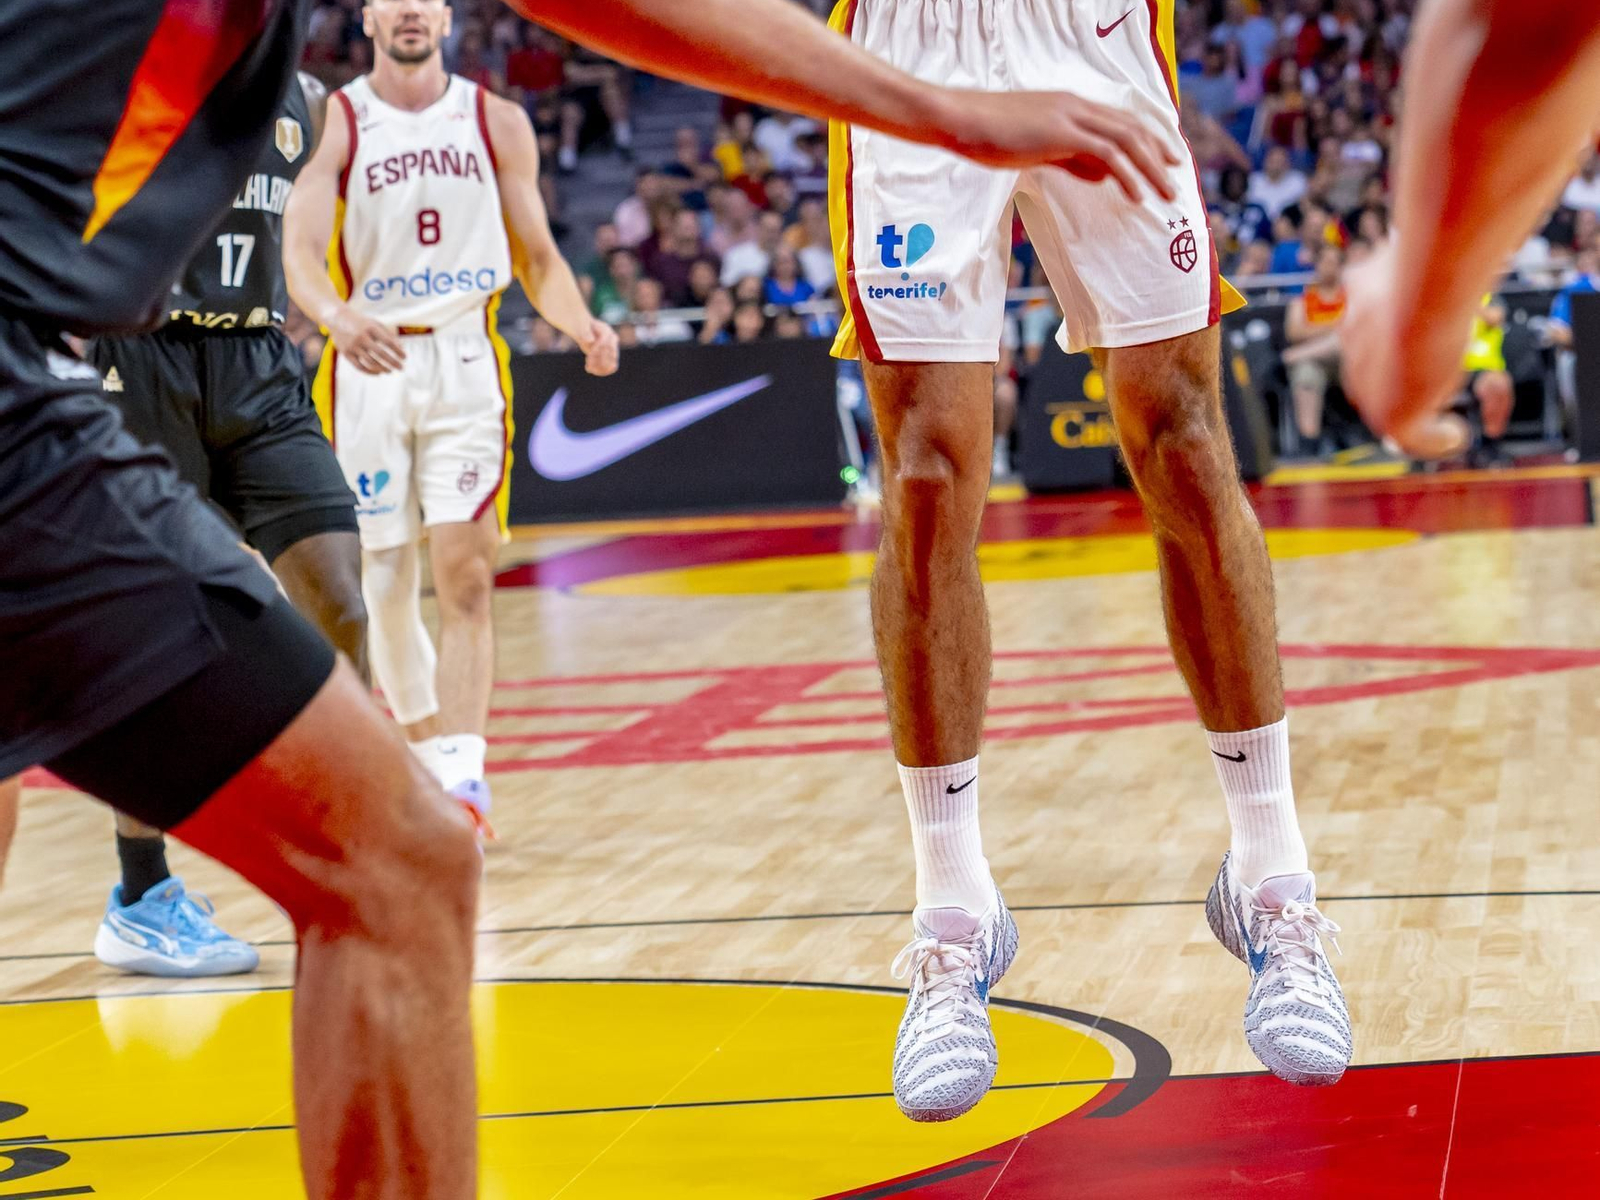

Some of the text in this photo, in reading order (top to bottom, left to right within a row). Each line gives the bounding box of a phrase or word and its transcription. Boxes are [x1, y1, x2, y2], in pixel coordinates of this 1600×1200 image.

[366, 143, 483, 194] ESPAÑA
[417, 208, 441, 247] 8
[216, 233, 256, 288] 17
[363, 267, 496, 301] endesa
